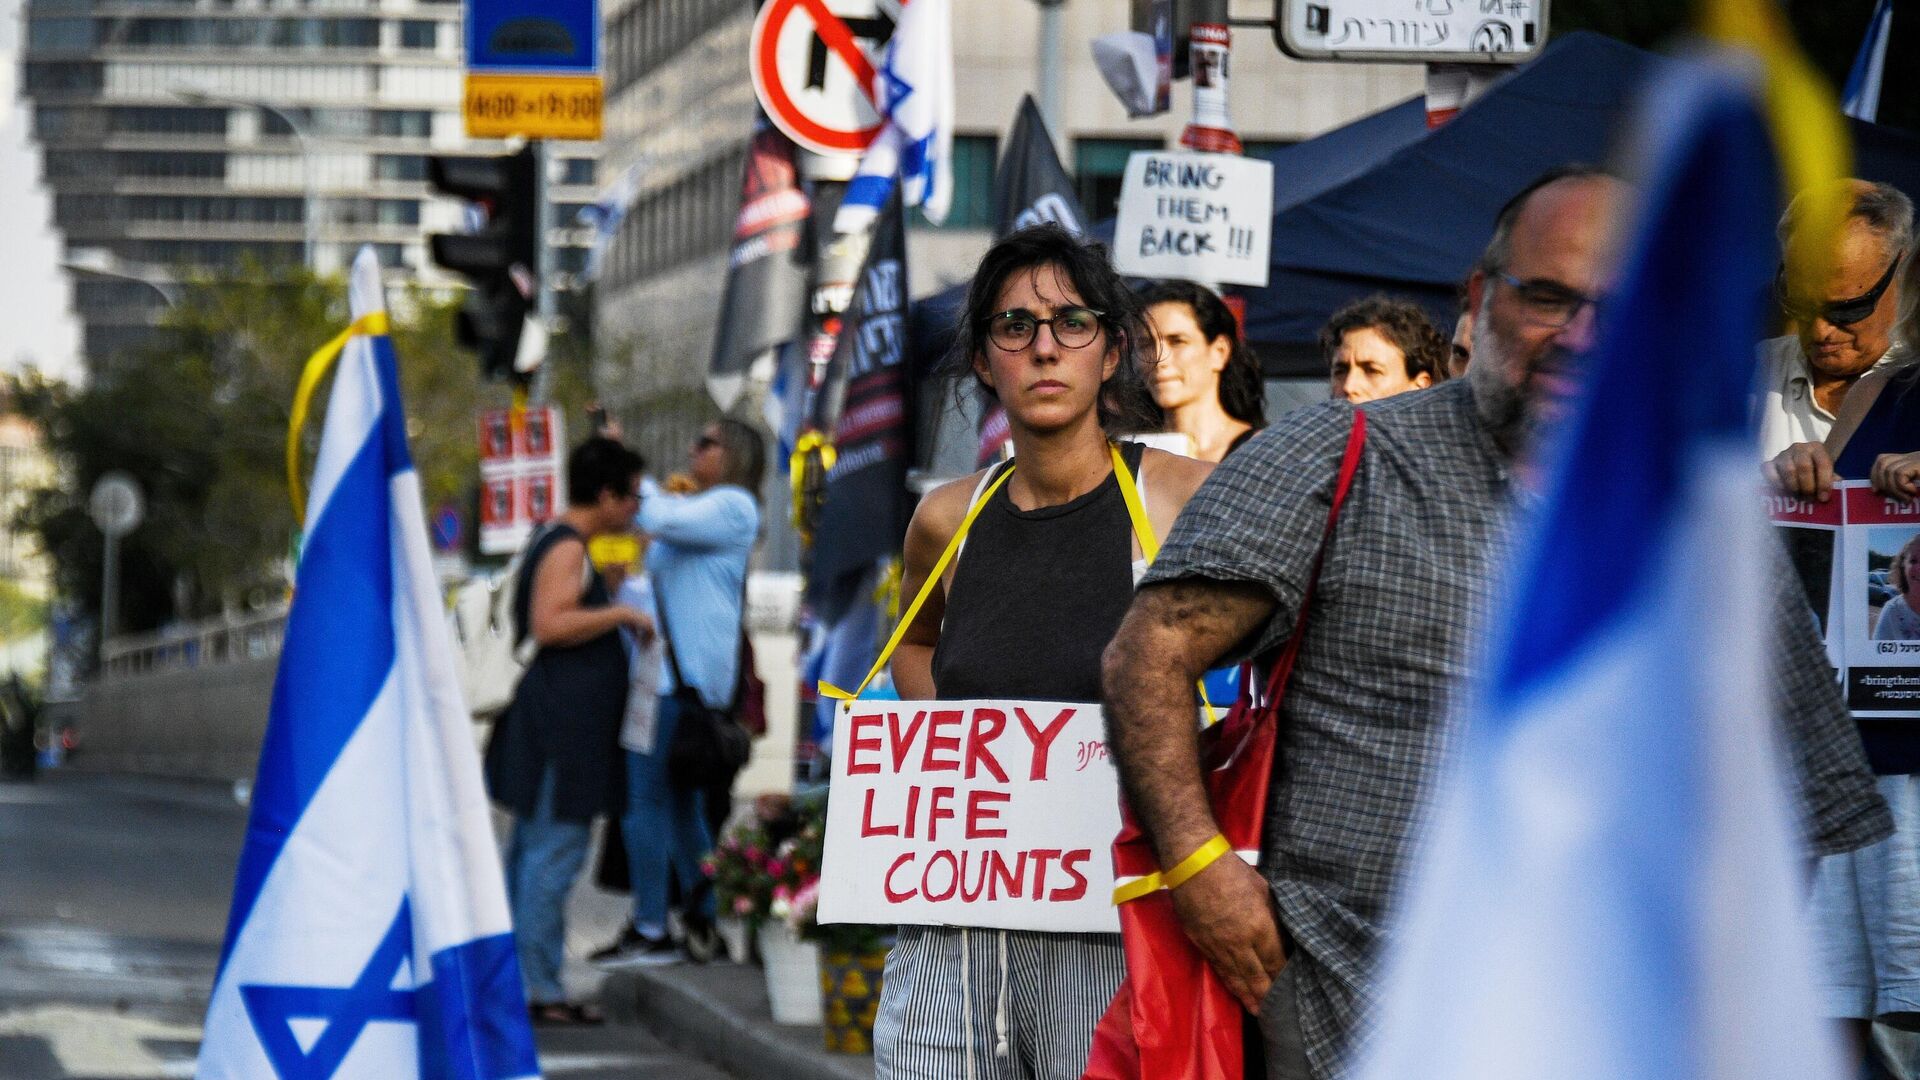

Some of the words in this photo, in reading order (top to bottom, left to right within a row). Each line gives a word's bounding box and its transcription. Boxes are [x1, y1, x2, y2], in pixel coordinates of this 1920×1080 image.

[1331, 17, 1450, 46] עיוורית
[1143, 157, 1224, 190] BRING
[1157, 195, 1229, 223] THEM
[1139, 225, 1216, 258] BACK
[1877, 642, 1898, 654] (62)
[847, 707, 1077, 783] EVERY
[861, 785, 1011, 841] LIFE
[884, 848, 1092, 903] COUNTS
